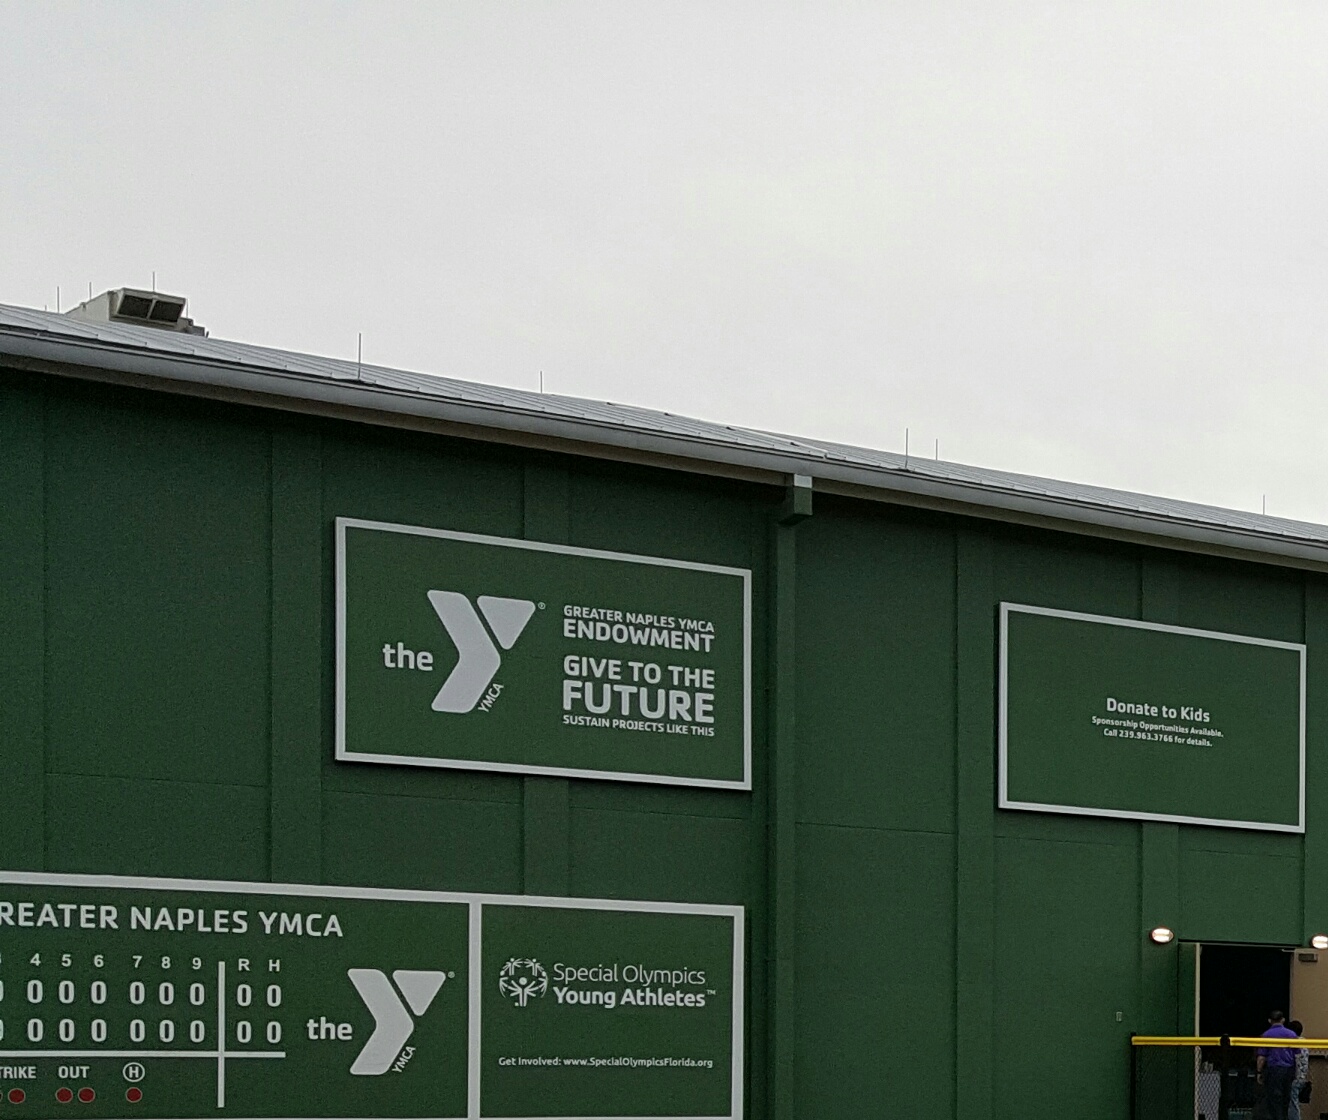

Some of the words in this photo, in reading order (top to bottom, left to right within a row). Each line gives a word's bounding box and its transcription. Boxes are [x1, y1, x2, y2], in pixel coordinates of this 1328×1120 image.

[564, 605, 622, 622] GREATER
[626, 613, 675, 628] NAPLES
[678, 618, 714, 632] YMCA
[564, 619, 714, 652] ENDOWMENT
[383, 642, 433, 671] the
[564, 655, 621, 679] GIVE
[628, 662, 661, 683] TO
[668, 666, 715, 689] THE
[477, 682, 504, 713] YMCA
[563, 680, 714, 724] FUTURE
[1107, 698, 1158, 716] Donate
[1161, 706, 1178, 719] to
[1181, 707, 1209, 722] Kids
[562, 715, 610, 728] SUSTAIN
[612, 719, 665, 733] PROJECTS
[666, 724, 689, 735] LIKE
[690, 726, 715, 737] THIS
[1091, 716, 1139, 730] Sponsorship
[1138, 721, 1189, 734] Opportunities
[1189, 727, 1224, 738] Available.
[1103, 728, 1118, 737] Call
[1174, 736, 1186, 744] for
[1186, 738, 1213, 747] details.
[0, 902, 118, 928] REATER
[131, 907, 247, 933] NAPLES
[259, 912, 343, 937] YMCA
[29, 953, 42, 967] 4
[61, 954, 72, 968] 5
[93, 955, 104, 968] 6
[132, 956, 143, 969] 7
[161, 956, 171, 969] 8
[192, 958, 202, 970] 9
[238, 959, 251, 972] R
[268, 960, 281, 972] H
[554, 963, 618, 984] Special
[623, 965, 705, 987] Olympics
[28, 980, 43, 1003] 0
[59, 981, 74, 1003] 0
[91, 981, 106, 1004] 0
[130, 982, 145, 1004] 0
[159, 982, 174, 1005] 0
[190, 983, 204, 1005] 0
[237, 984, 251, 1006] 0
[267, 985, 281, 1006] 0
[553, 987, 615, 1008] Young
[620, 988, 705, 1007] Athletes
[28, 1019, 43, 1042] 0
[59, 1019, 74, 1041] 0
[91, 1019, 106, 1042] 0
[130, 1019, 145, 1042] 0
[160, 1020, 174, 1042] 0
[190, 1020, 204, 1042] 0
[237, 1021, 251, 1043] 0
[267, 1021, 281, 1043] 0
[307, 1017, 352, 1040] the
[391, 1046, 416, 1073] YMCA
[498, 1057, 517, 1066] Get
[518, 1057, 562, 1066] Involved:
[562, 1057, 714, 1069] www.SpecialOlympicsFlorida.org
[58, 1066, 90, 1079] OUT
